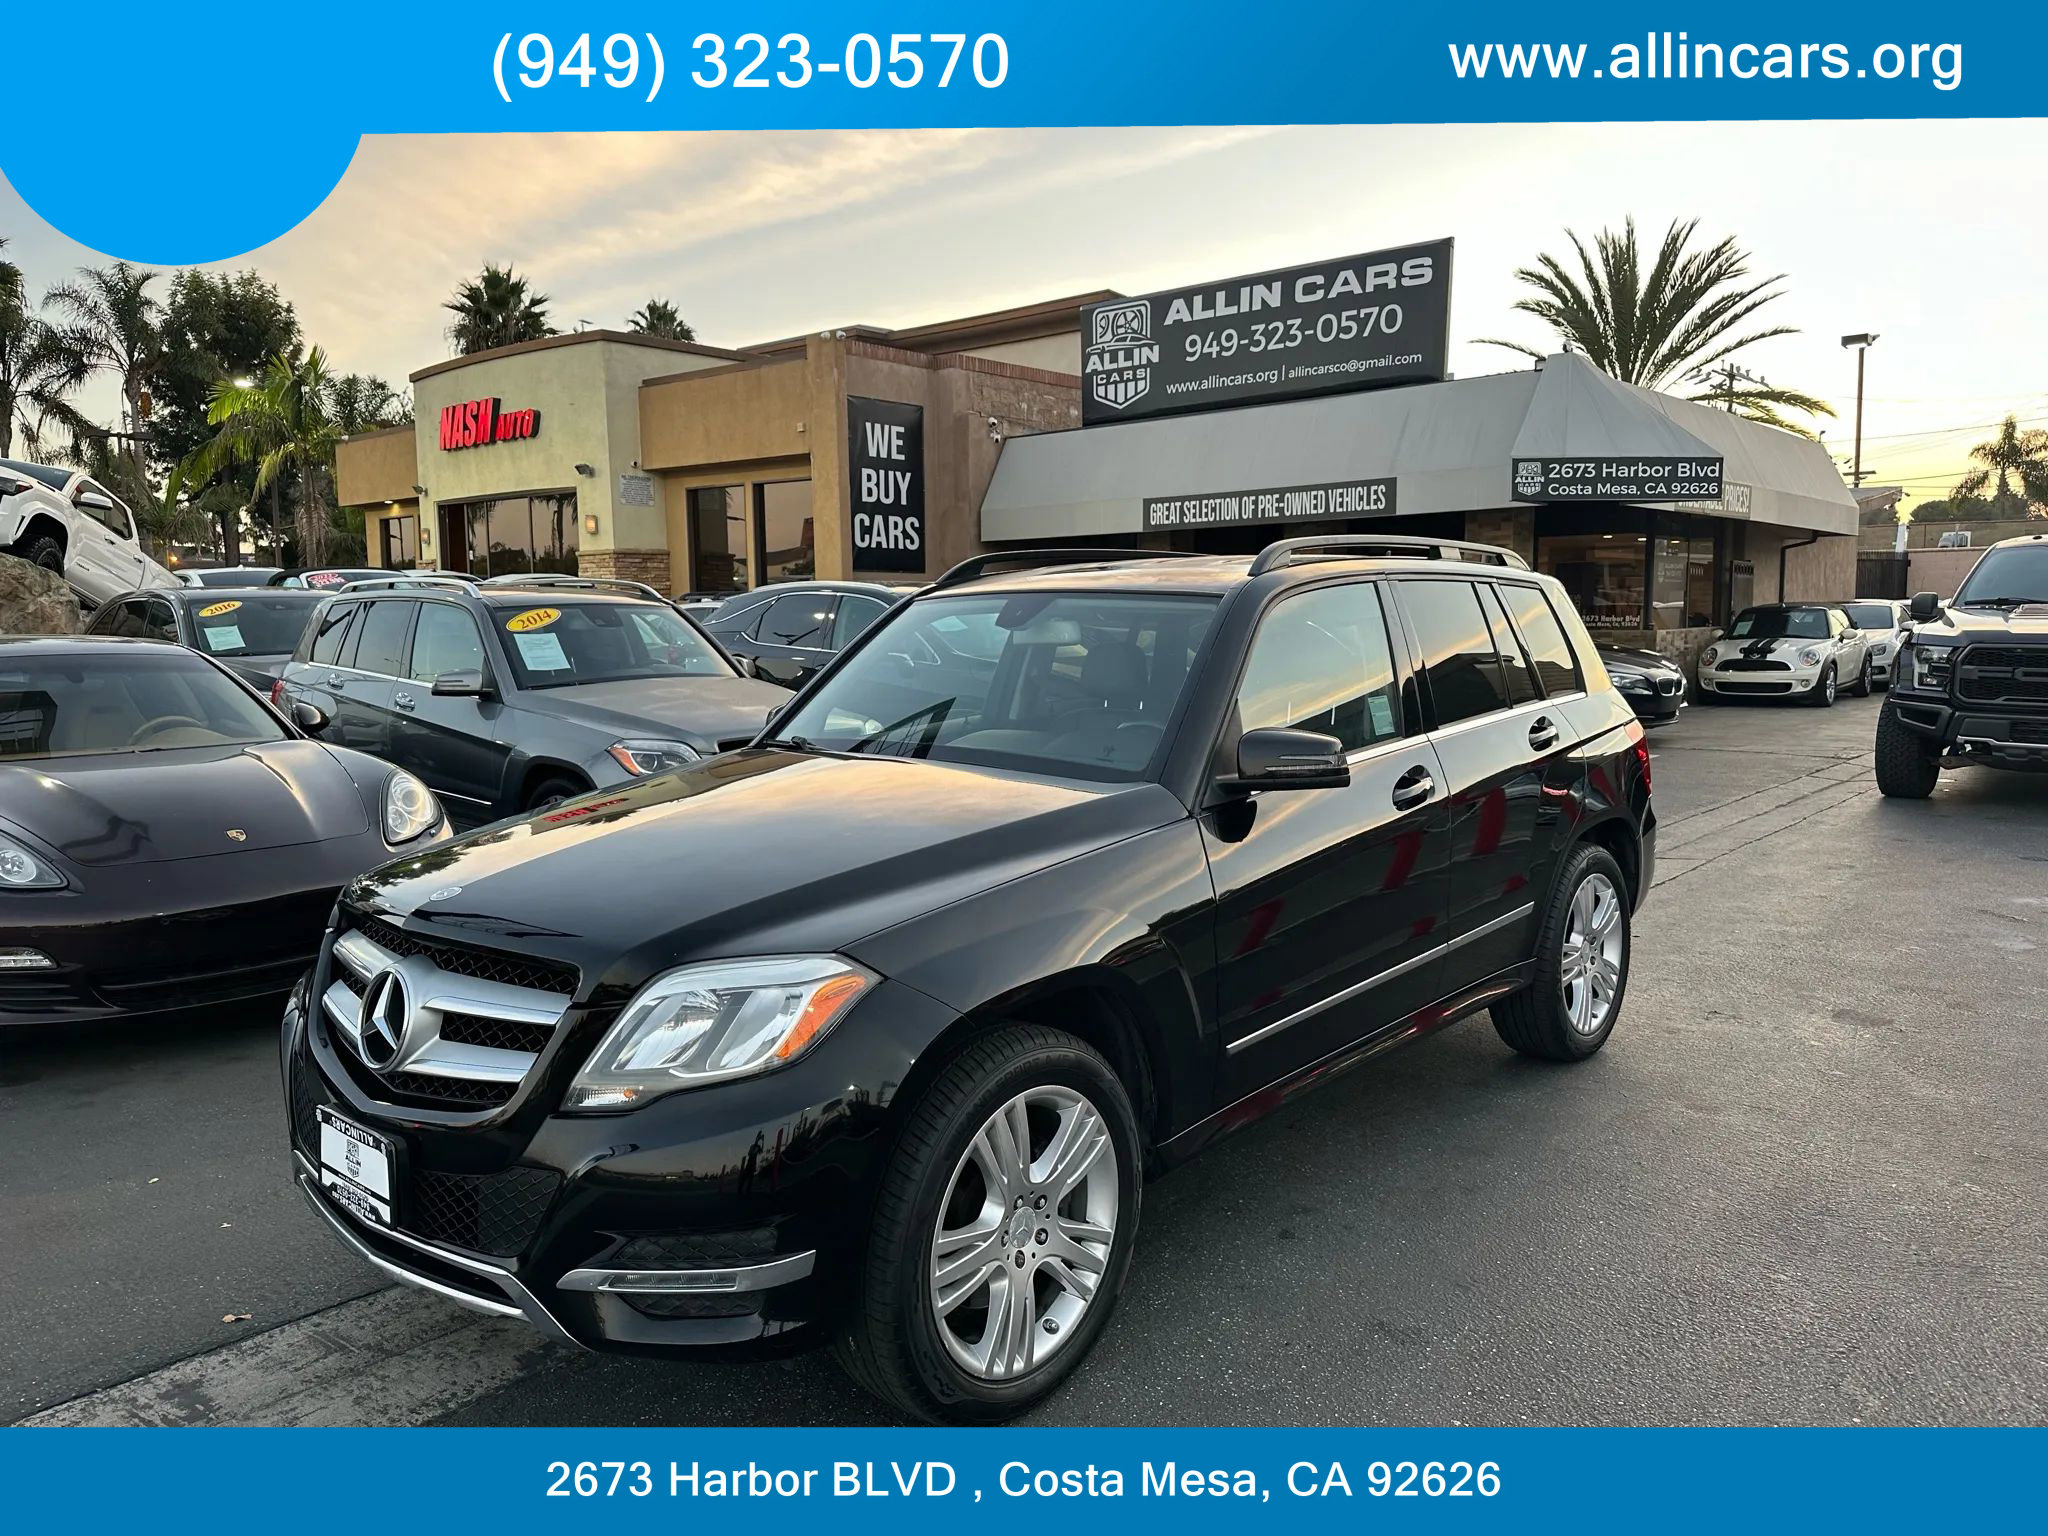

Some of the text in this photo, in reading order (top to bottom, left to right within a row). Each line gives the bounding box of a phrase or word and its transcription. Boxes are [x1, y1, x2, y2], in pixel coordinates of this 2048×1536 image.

[1163, 257, 1433, 326] ALLIN CARS
[1185, 304, 1403, 362] 949-323-0570
[1085, 345, 1160, 374] ALLIN
[1097, 368, 1146, 384] CARS
[1166, 371, 1278, 394] www.allincars.org
[1288, 353, 1423, 378] allincarsco@gmail.com
[440, 398, 536, 451] NASH AUTO
[865, 421, 906, 460] WE
[861, 467, 912, 505] BUY
[1514, 475, 1545, 483] ALLIN
[1548, 462, 1720, 478] 2673 Harbor Blvd
[1149, 484, 1386, 525] GREAT SELECTION OF PRE-OWNED VEHICLES
[1548, 482, 1719, 496] Costa Mesa, CA 92626
[1724, 484, 1750, 513] PRICES!
[854, 513, 920, 550] CARS
[206, 603, 236, 614] 2016
[517, 610, 552, 629] 2014
